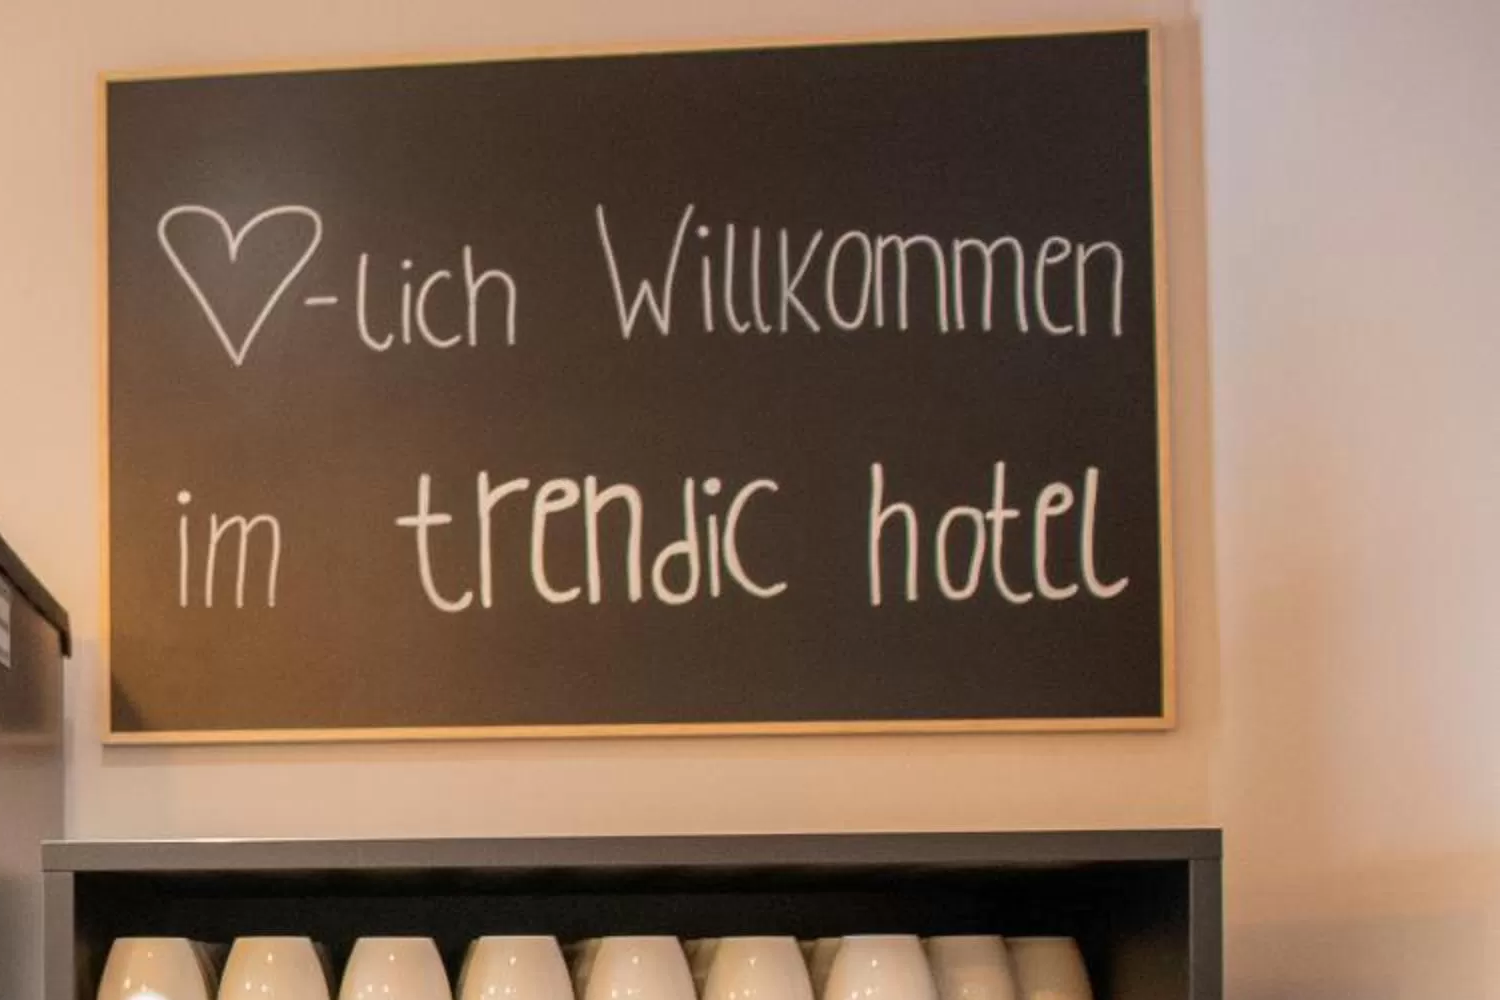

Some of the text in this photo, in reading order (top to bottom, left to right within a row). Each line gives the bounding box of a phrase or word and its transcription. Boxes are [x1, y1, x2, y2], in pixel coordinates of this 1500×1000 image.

[596, 204, 1126, 341] Willkommen
[176, 460, 1130, 613] im trendic hotel
